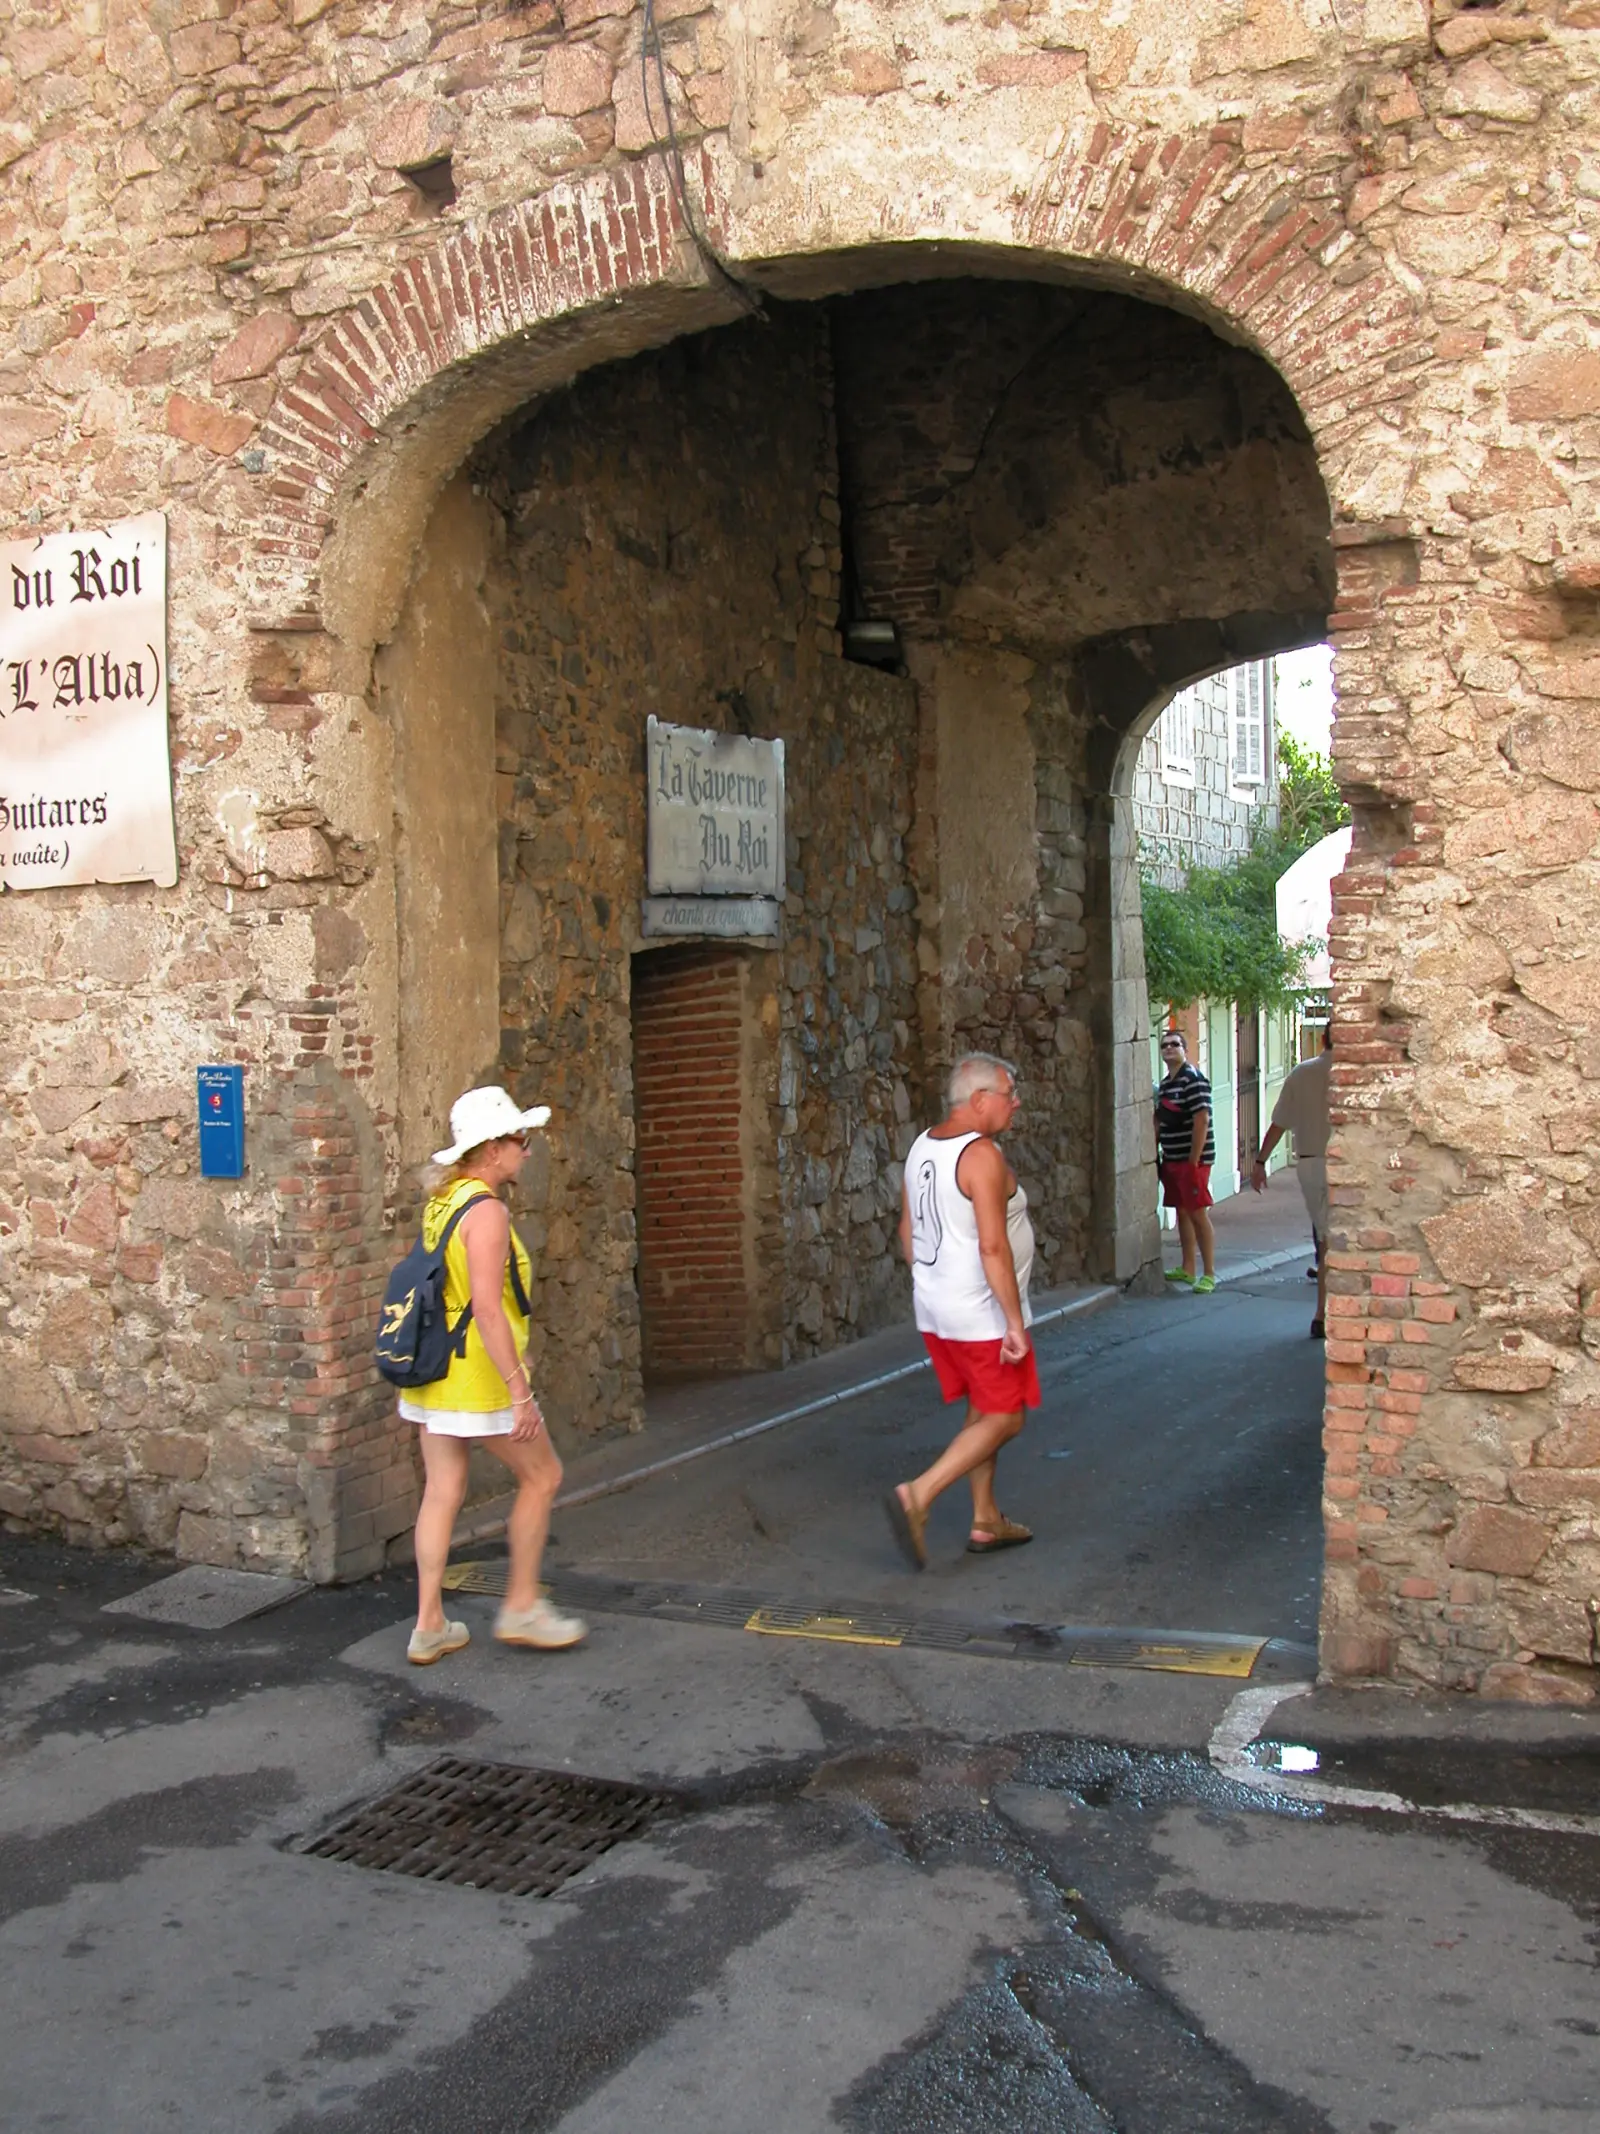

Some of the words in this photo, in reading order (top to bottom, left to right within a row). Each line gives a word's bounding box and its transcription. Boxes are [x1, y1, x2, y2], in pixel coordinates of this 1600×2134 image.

[11, 563, 55, 611] du
[70, 542, 143, 603] Roi
[0, 643, 160, 718] L'Alba)
[654, 740, 683, 806] La
[685, 746, 767, 808] Taverne
[12, 840, 70, 870] voûte)
[698, 813, 731, 872] Du
[734, 819, 769, 875] Roi
